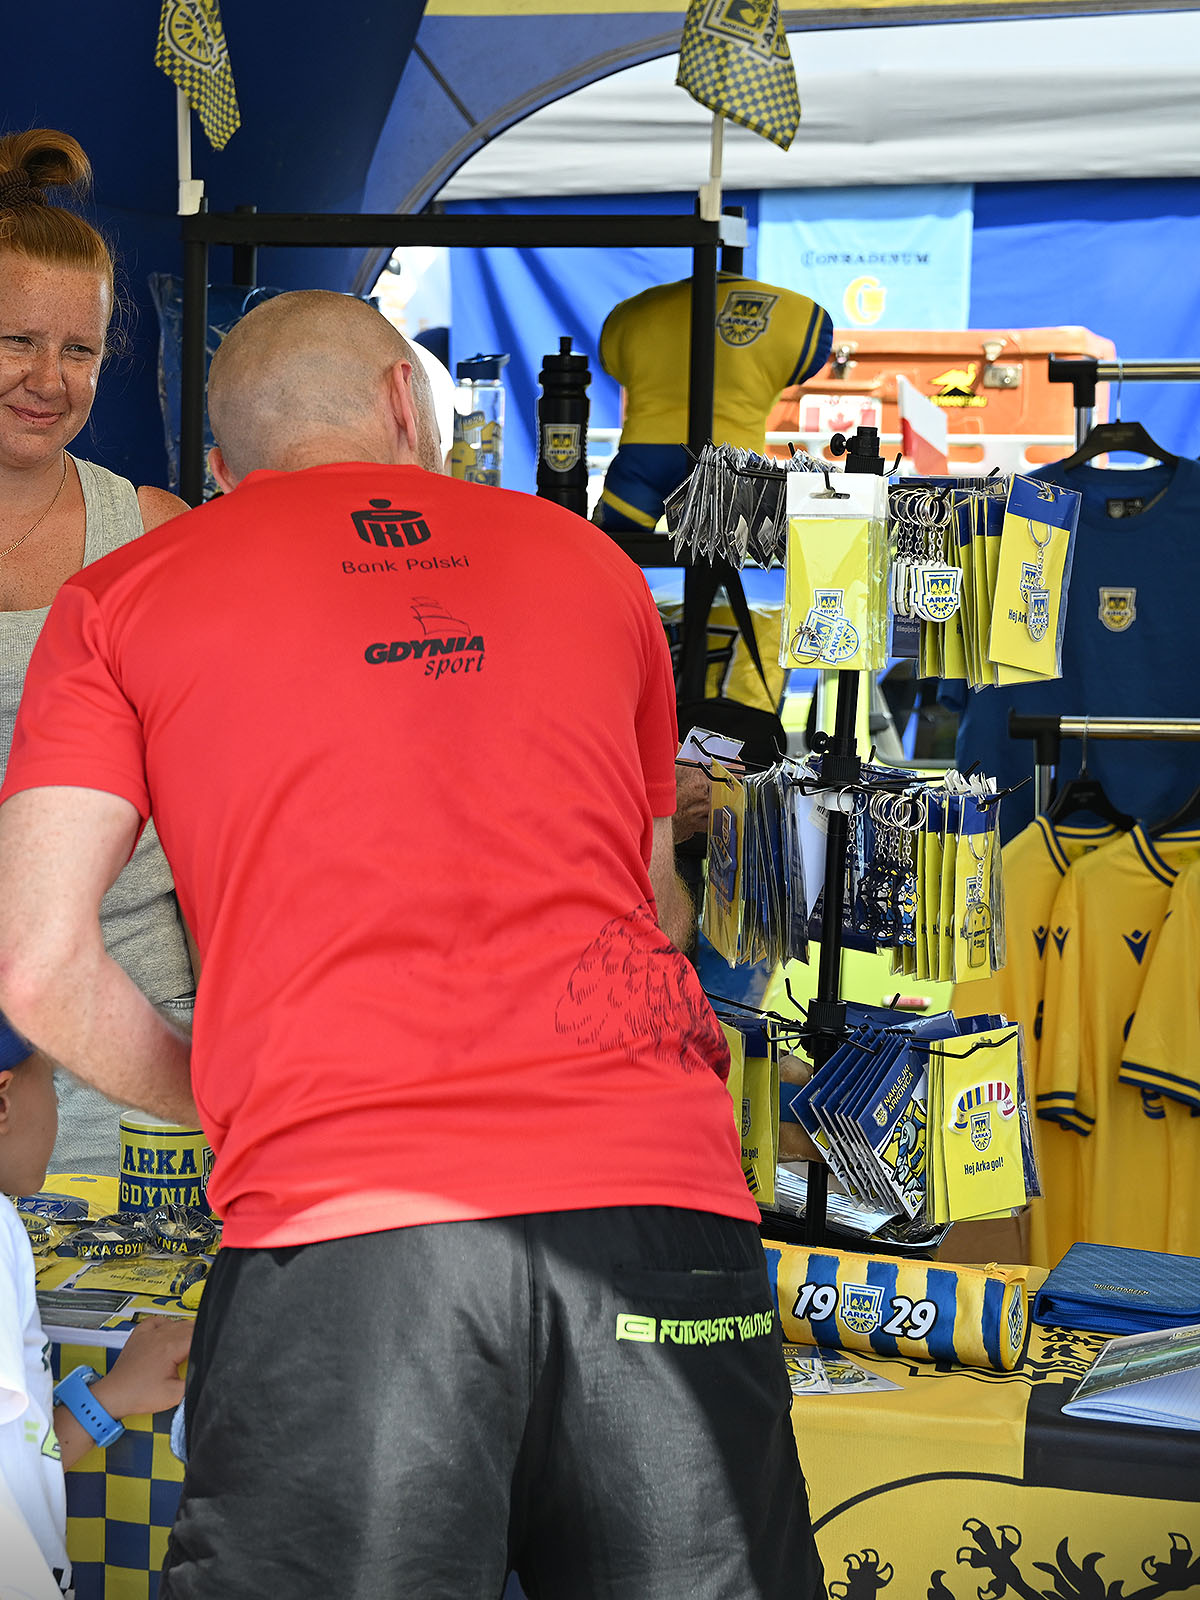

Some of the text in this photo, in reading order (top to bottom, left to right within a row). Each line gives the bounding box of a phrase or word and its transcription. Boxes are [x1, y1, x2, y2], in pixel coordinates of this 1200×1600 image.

[341, 555, 470, 575] Bank Polski
[1008, 609, 1028, 624] Hej Ark
[1032, 617, 1046, 625] ARKA
[364, 635, 485, 665] GDYNIA
[830, 625, 845, 656] ARKA
[424, 652, 485, 681] sport
[884, 1063, 910, 1107] NAKLEJKI
[888, 1072, 914, 1114] ARKOWCA
[122, 1144, 197, 1175] ARKA
[964, 1156, 1004, 1175] Hej Arka gol!
[121, 1182, 201, 1207] GDYNIA
[156, 1235, 188, 1252] YNIA
[793, 1283, 838, 1320] 19
[846, 1310, 874, 1320] ARKA
[659, 1317, 735, 1346] FUTURISTIC
[883, 1297, 937, 1339] 29
